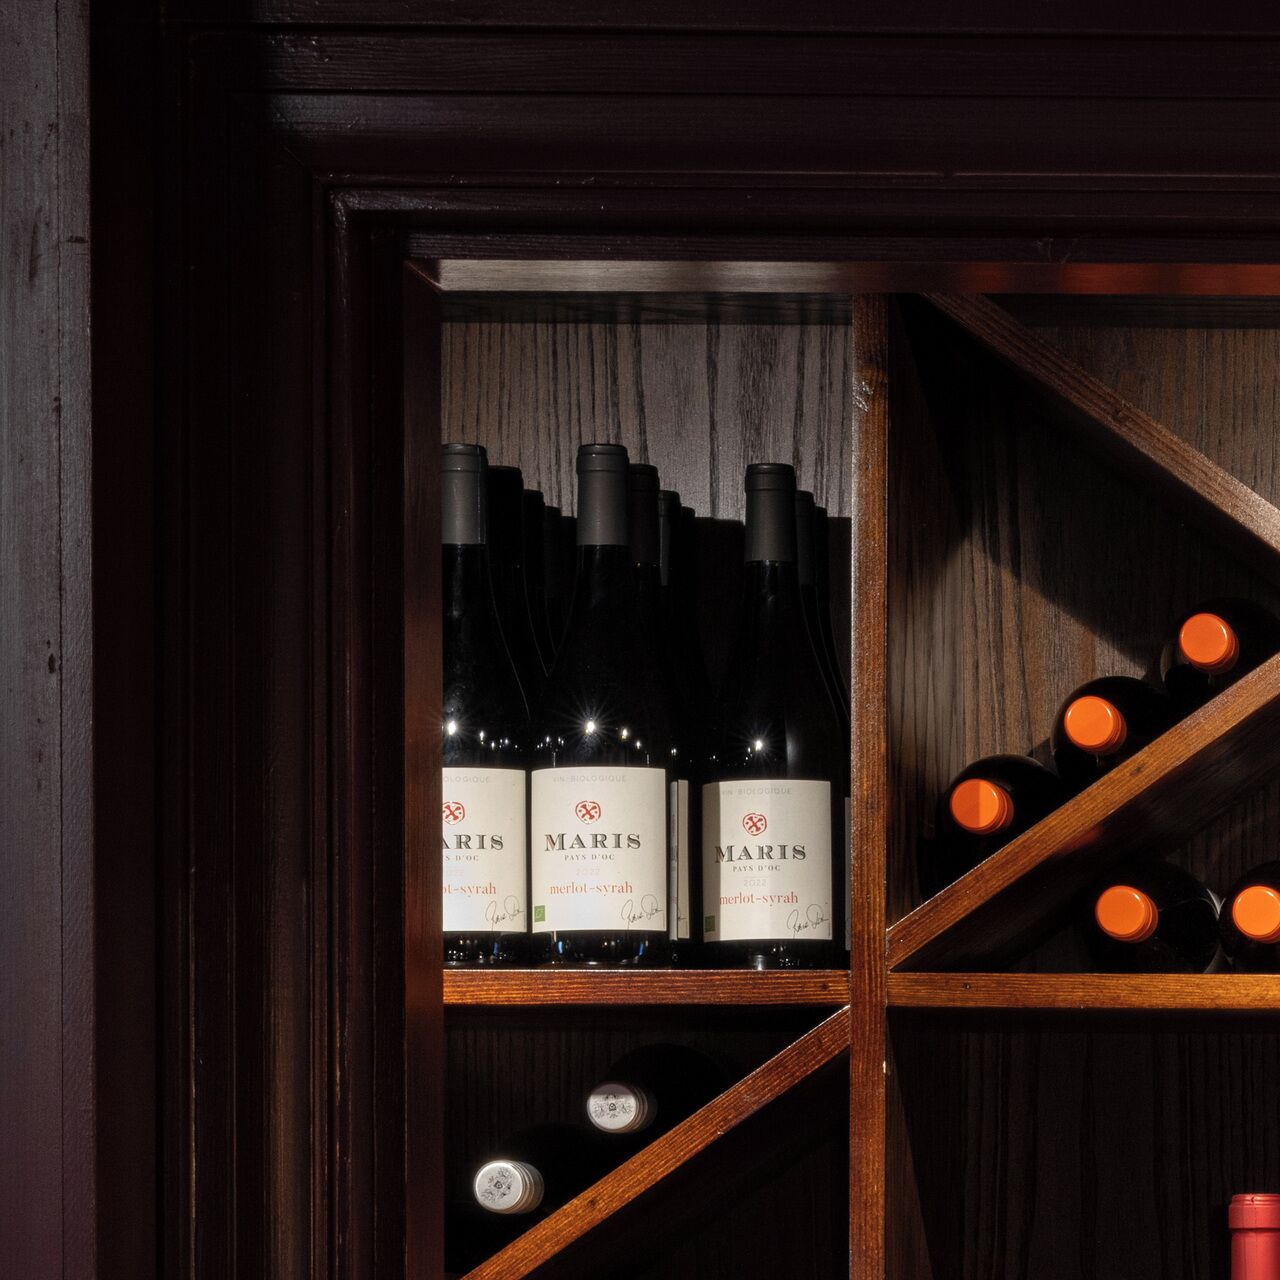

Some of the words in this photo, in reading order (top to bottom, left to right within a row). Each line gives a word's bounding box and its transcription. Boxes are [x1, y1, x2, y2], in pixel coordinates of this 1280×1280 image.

[544, 832, 641, 851] MARIS
[591, 853, 615, 861] D'OC
[714, 844, 807, 864] MARIS
[549, 881, 633, 897] merlot-syrah
[719, 891, 799, 908] merlot-syrah
